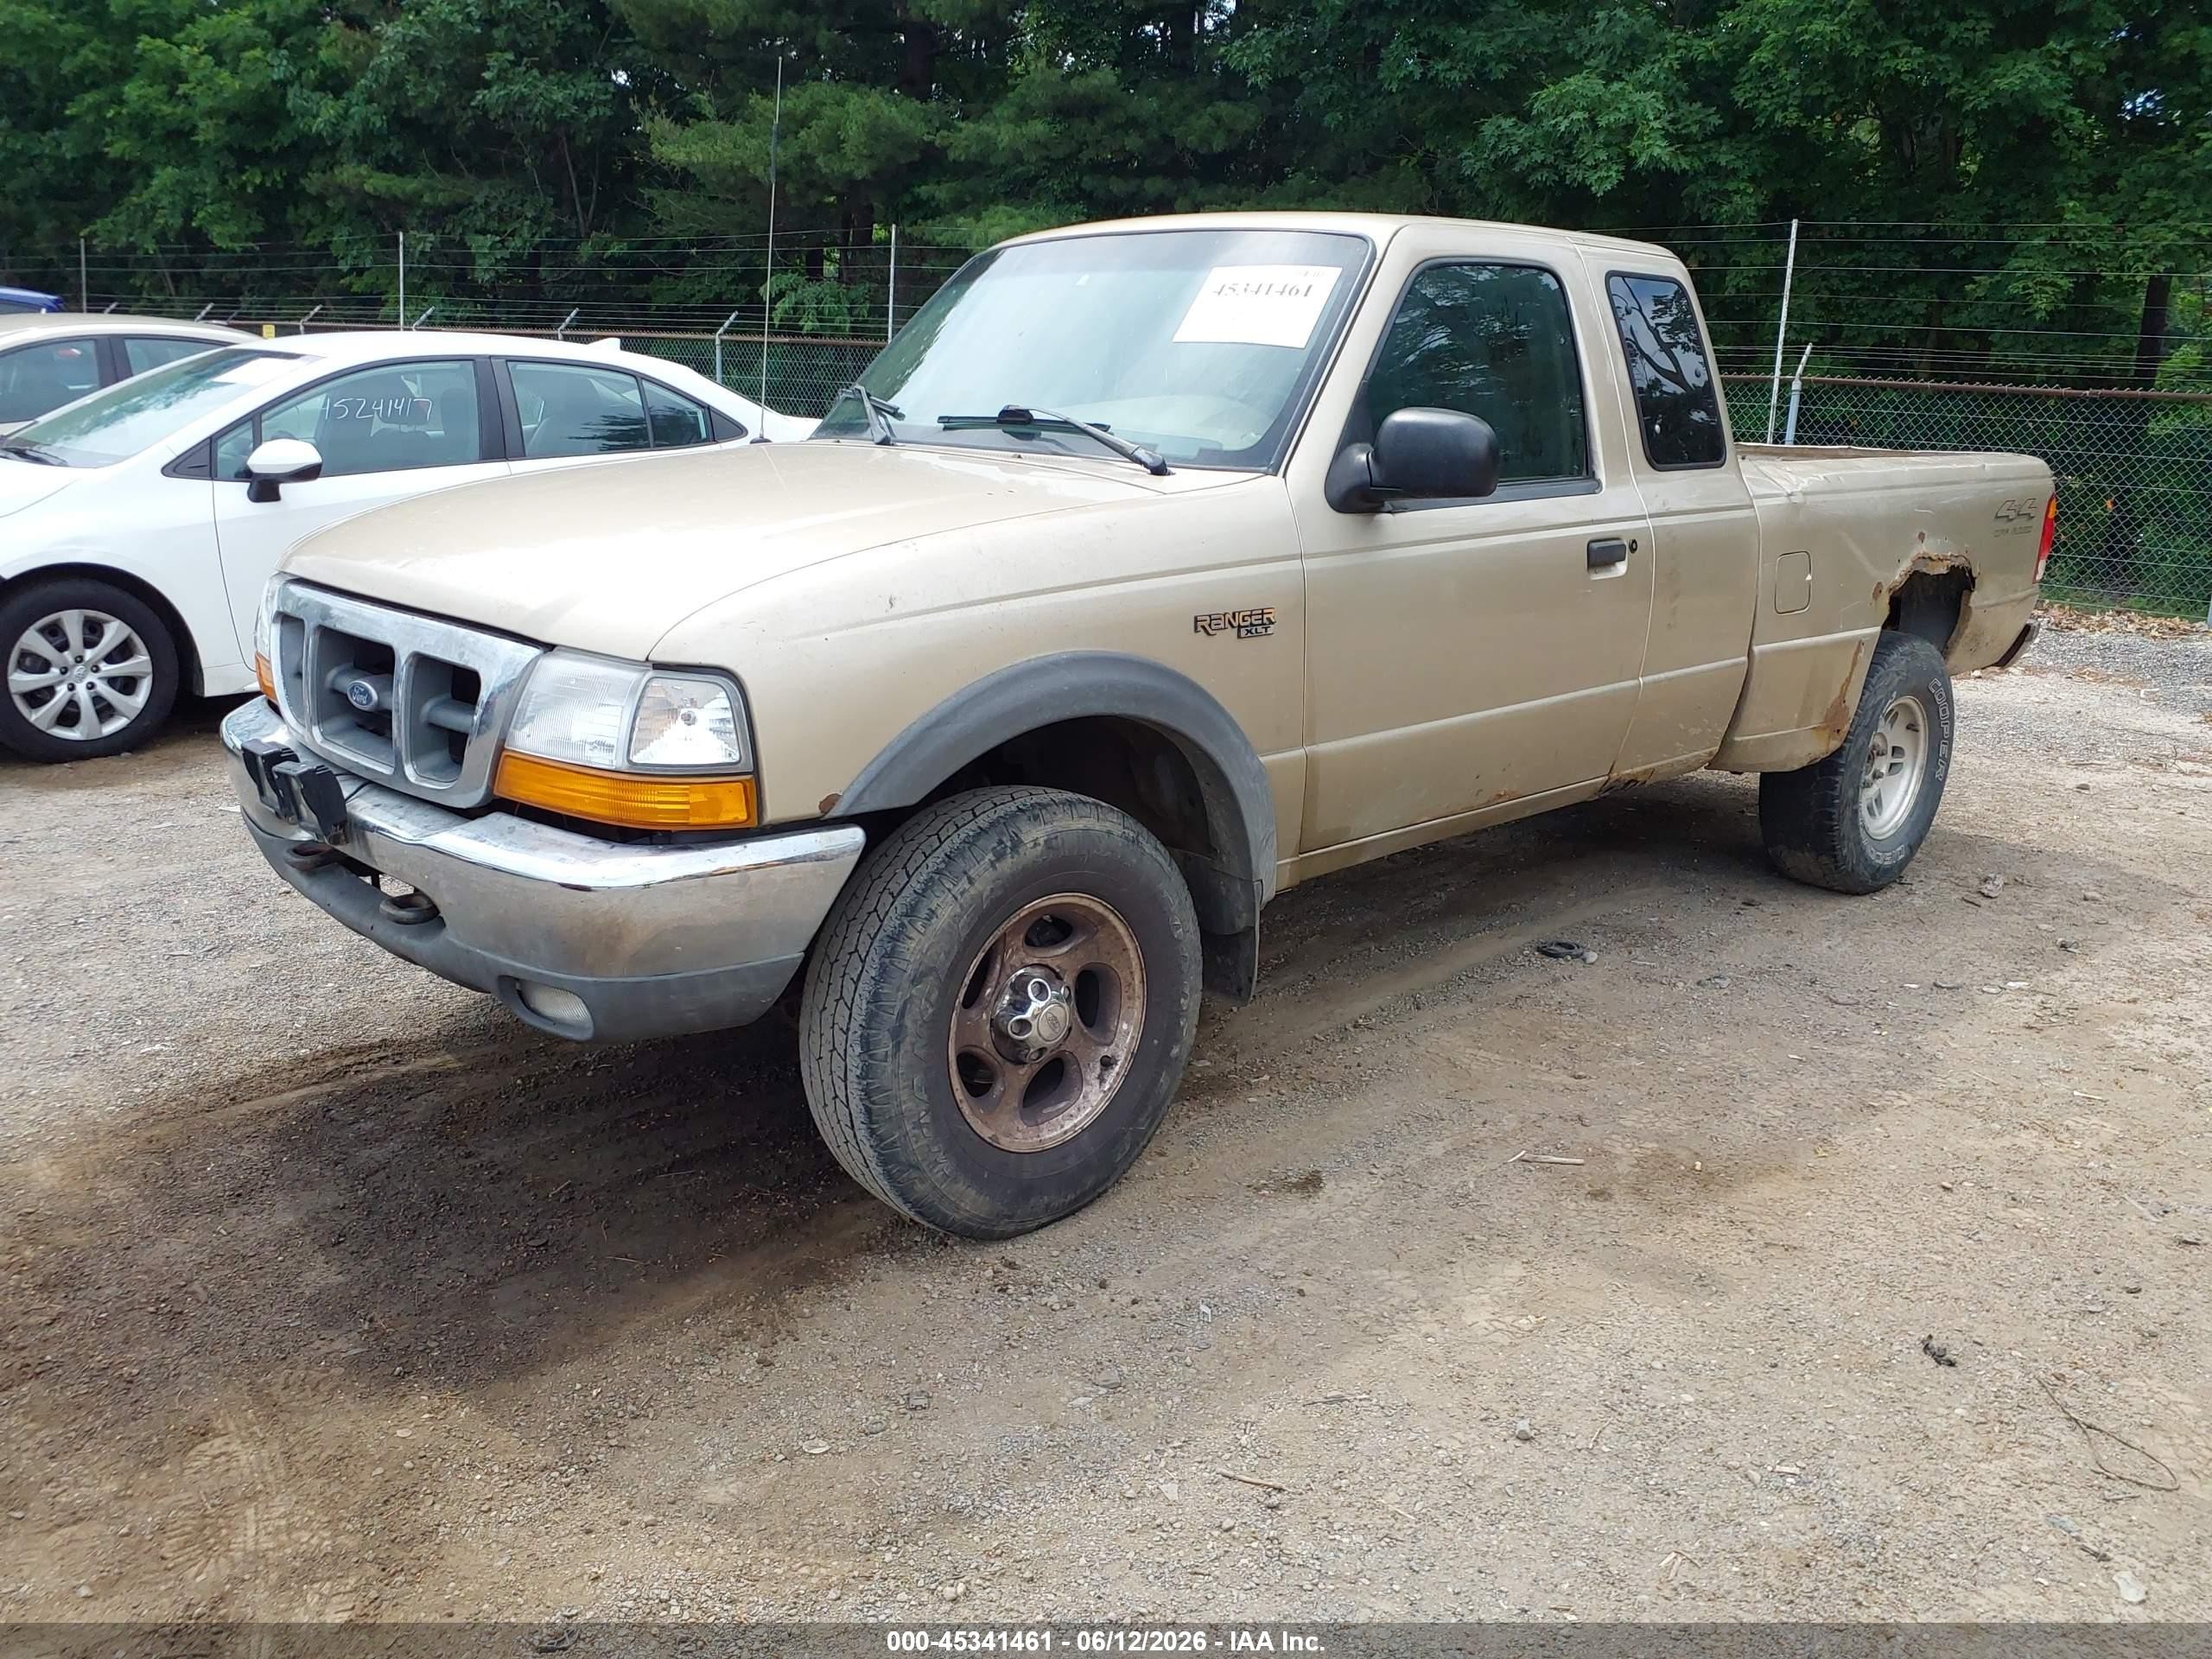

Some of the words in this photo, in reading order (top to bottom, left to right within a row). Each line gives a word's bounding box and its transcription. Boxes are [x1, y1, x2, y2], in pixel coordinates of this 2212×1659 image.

[1212, 282, 1313, 297] 45341461
[1244, 626, 1271, 636] XLT
[352, 685, 370, 704] Ford
[1928, 677, 1950, 782] COOPER
